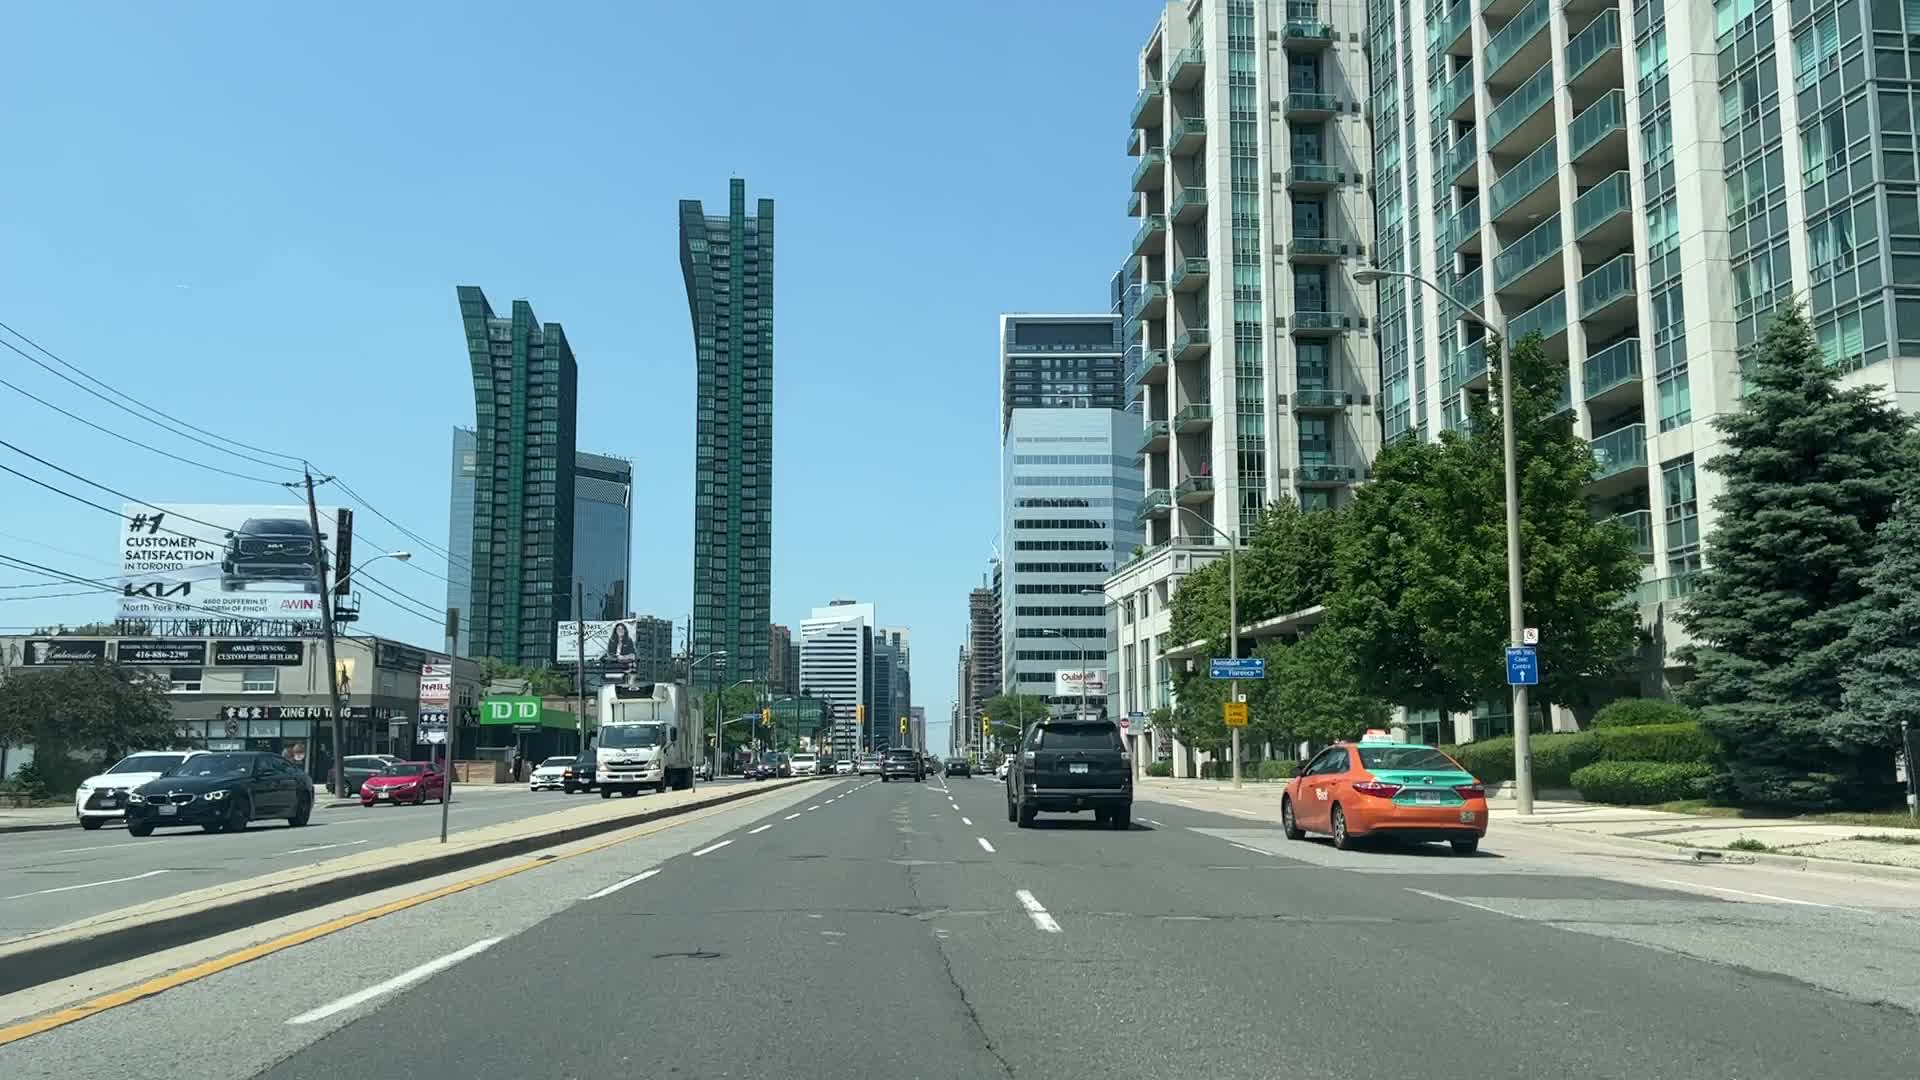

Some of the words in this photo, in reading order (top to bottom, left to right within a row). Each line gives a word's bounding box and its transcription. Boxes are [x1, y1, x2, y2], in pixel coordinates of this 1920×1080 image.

[130, 513, 165, 534] #1
[126, 537, 197, 547] CUSTOMER
[125, 550, 214, 560] SATISFACTION
[124, 562, 134, 570] IN
[136, 562, 183, 570] TORONTO
[124, 582, 191, 597] KIA
[122, 604, 149, 612] North
[153, 604, 172, 612] York
[280, 600, 314, 609] AWIN
[280, 708, 305, 719] XING
[307, 708, 321, 718] FU
[324, 708, 352, 718] TG
[487, 702, 513, 719] TD
[515, 702, 538, 719] TD
